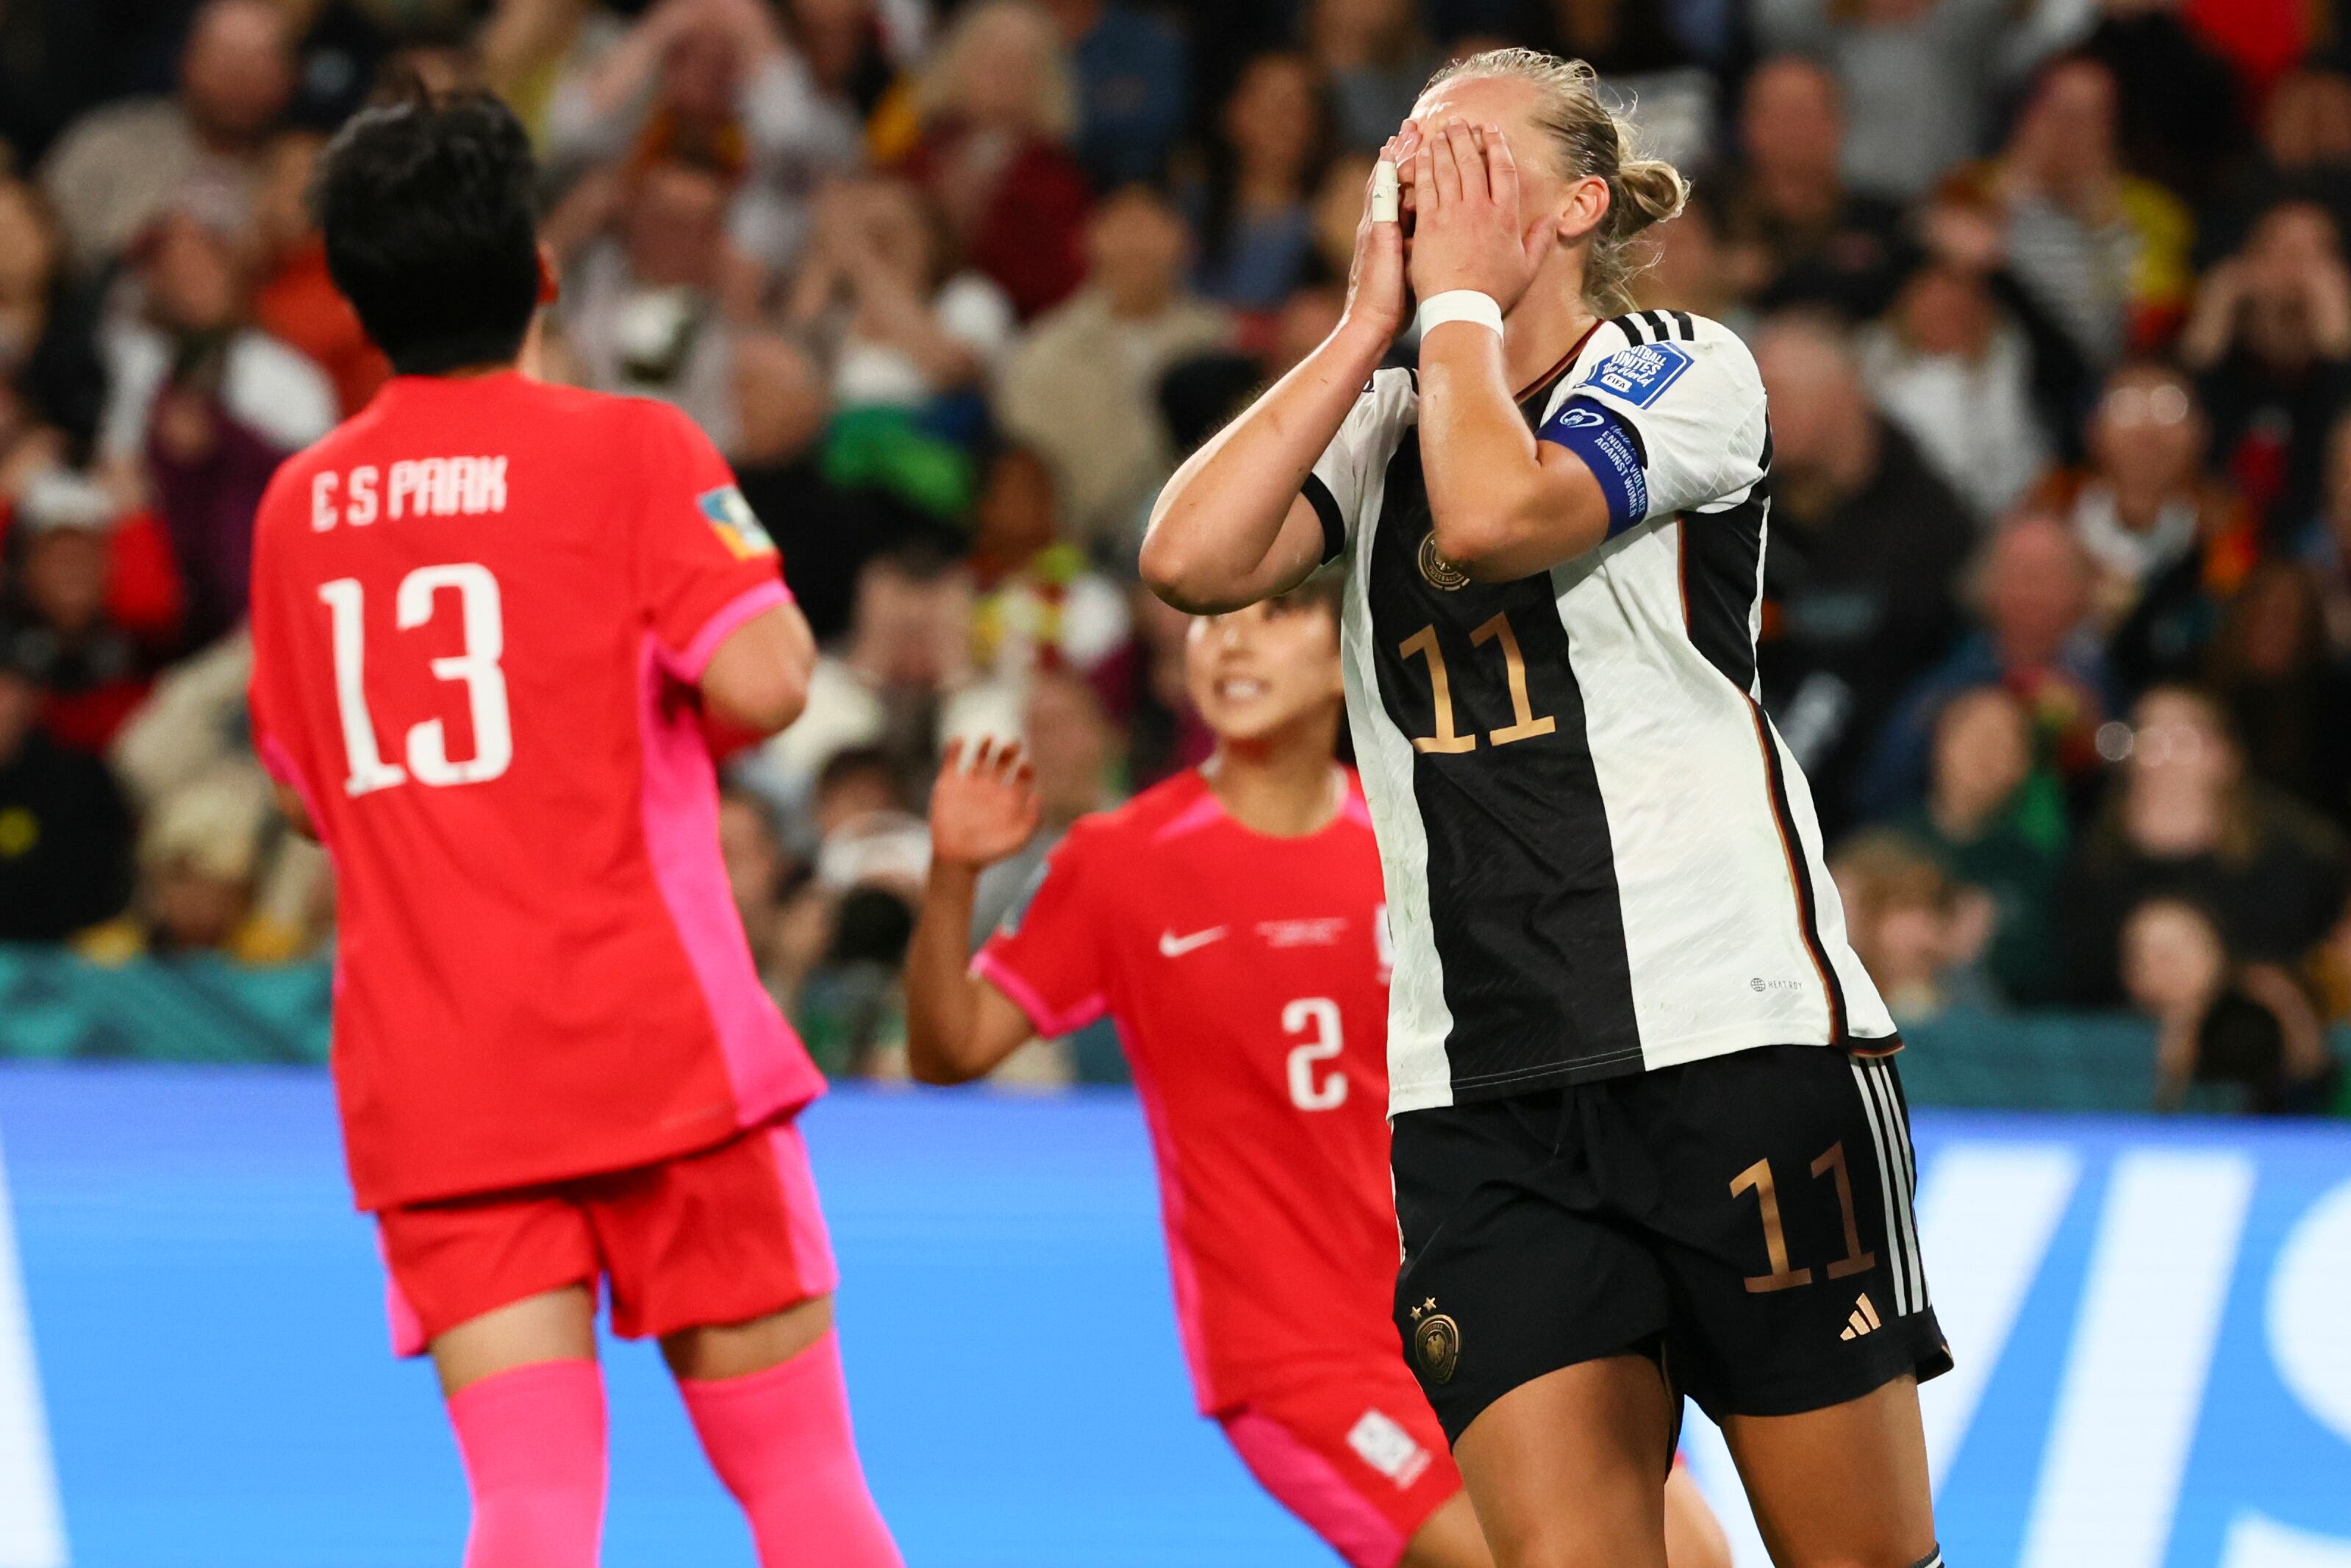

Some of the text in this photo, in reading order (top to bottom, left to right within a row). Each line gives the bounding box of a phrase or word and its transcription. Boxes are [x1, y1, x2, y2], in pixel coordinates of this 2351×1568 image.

[1602, 362, 1655, 388] the World
[1606, 375, 1625, 389] FIFA
[1611, 351, 1661, 376] UNITES
[1628, 345, 1666, 366] OTBALL
[311, 455, 509, 532] E S PARK
[1594, 437, 1629, 476] AGAINST
[1601, 430, 1647, 514] ENDING VIOLENCE
[318, 562, 514, 798] 13
[1398, 611, 1556, 753] 11
[1281, 996, 1348, 1111] 2
[1729, 1140, 1875, 1293] 11
